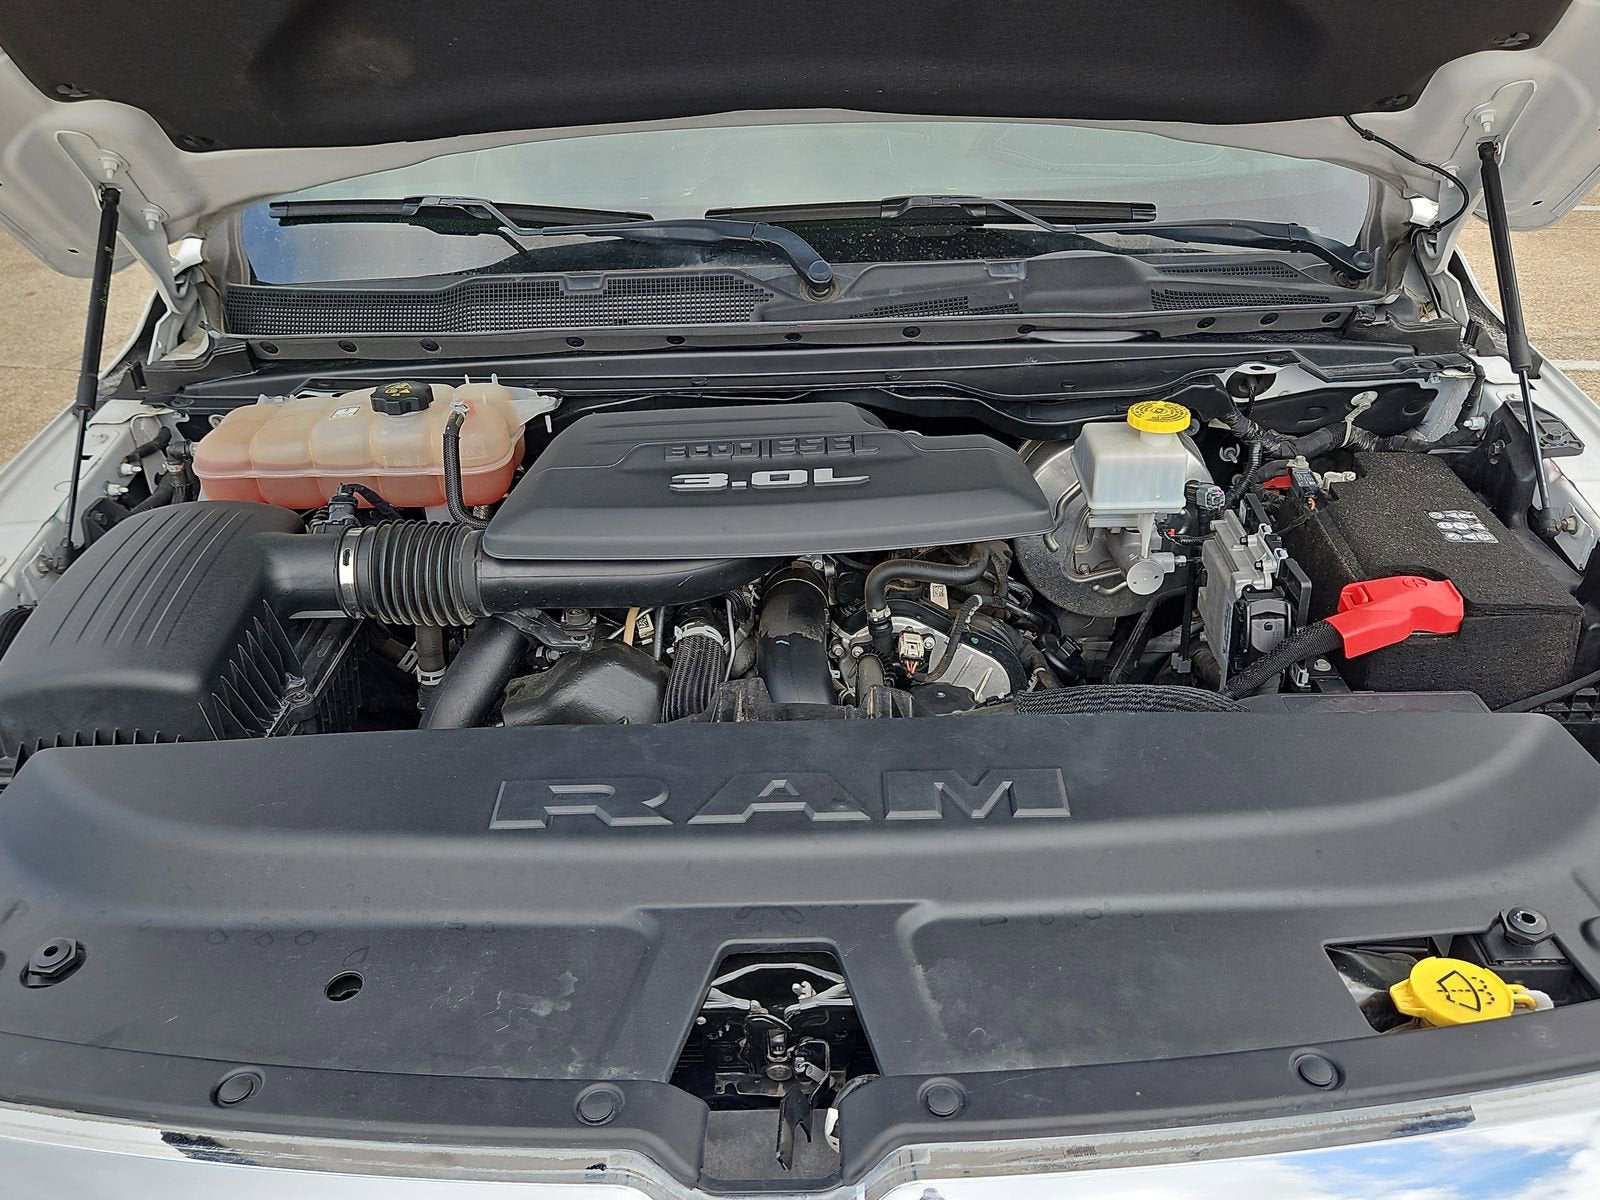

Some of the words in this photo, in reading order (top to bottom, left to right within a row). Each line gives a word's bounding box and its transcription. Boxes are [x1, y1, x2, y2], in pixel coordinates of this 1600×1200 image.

[664, 434, 880, 461] ECODIESEL
[669, 467, 871, 492] 3.0L
[488, 766, 1072, 830] RAM
